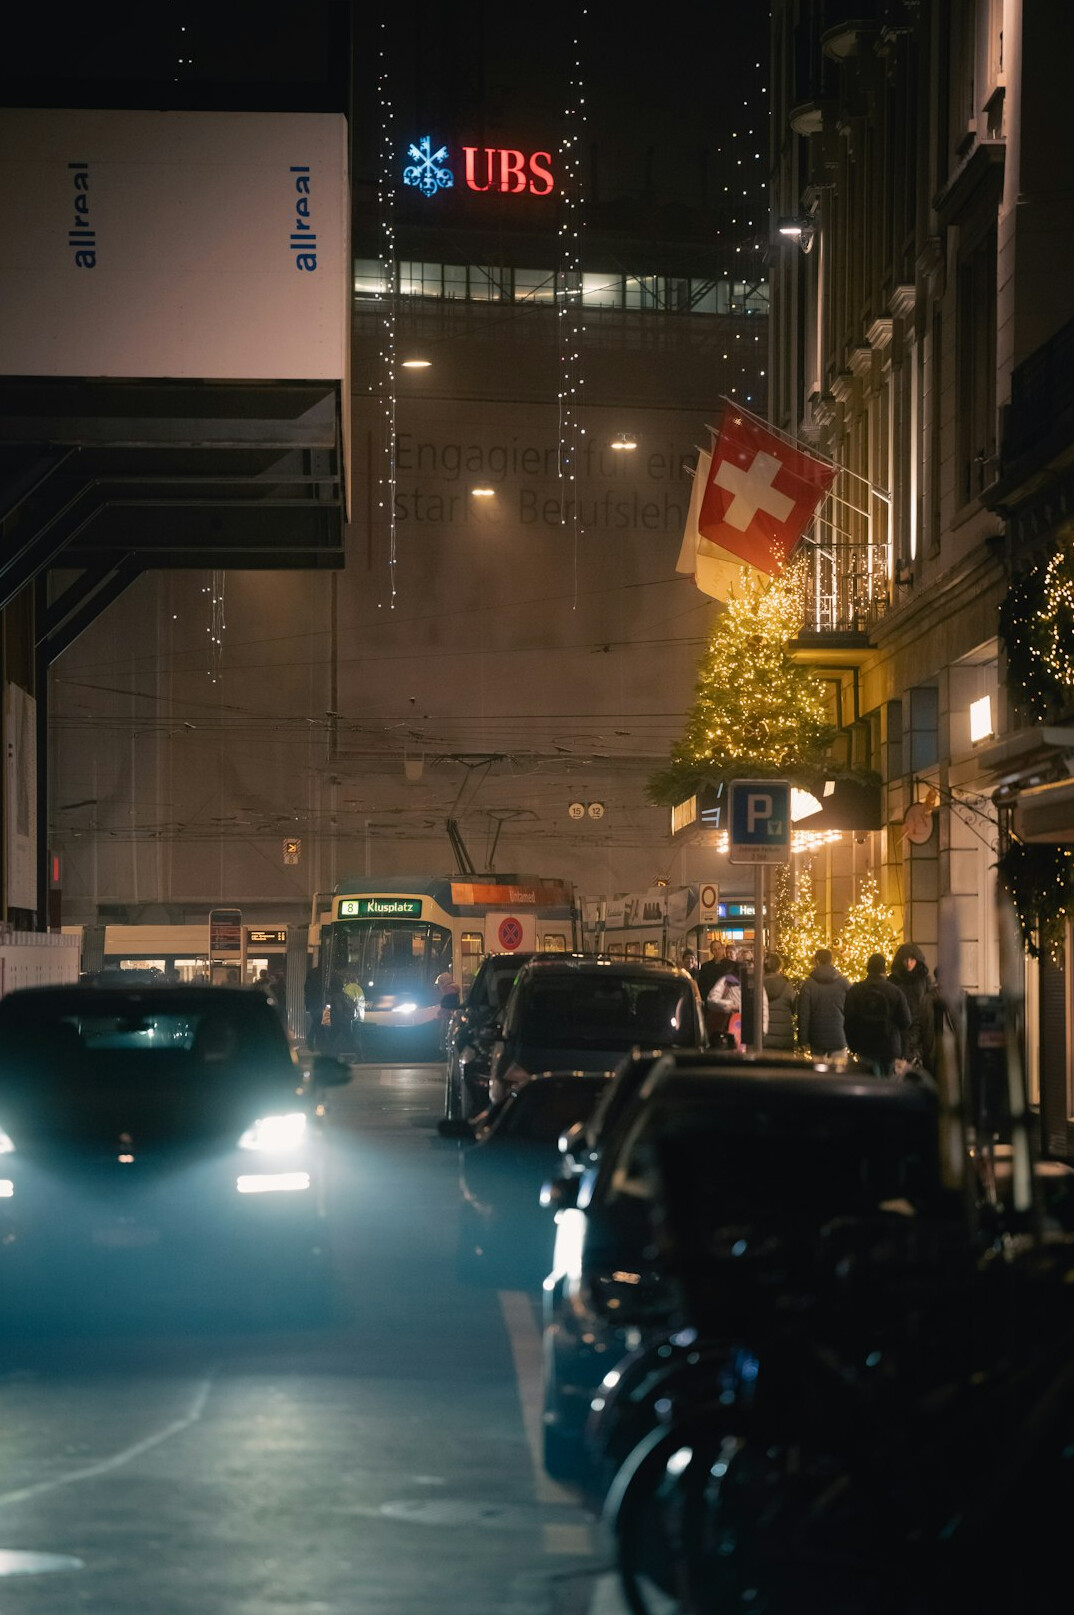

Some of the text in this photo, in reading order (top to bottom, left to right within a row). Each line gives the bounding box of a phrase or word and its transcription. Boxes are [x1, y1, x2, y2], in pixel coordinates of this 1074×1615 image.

[462, 146, 554, 195] UBS
[68, 163, 96, 269] allreal
[290, 166, 317, 272] allreal
[747, 794, 773, 833] P
[347, 902, 414, 914] 8 Klusplatz
